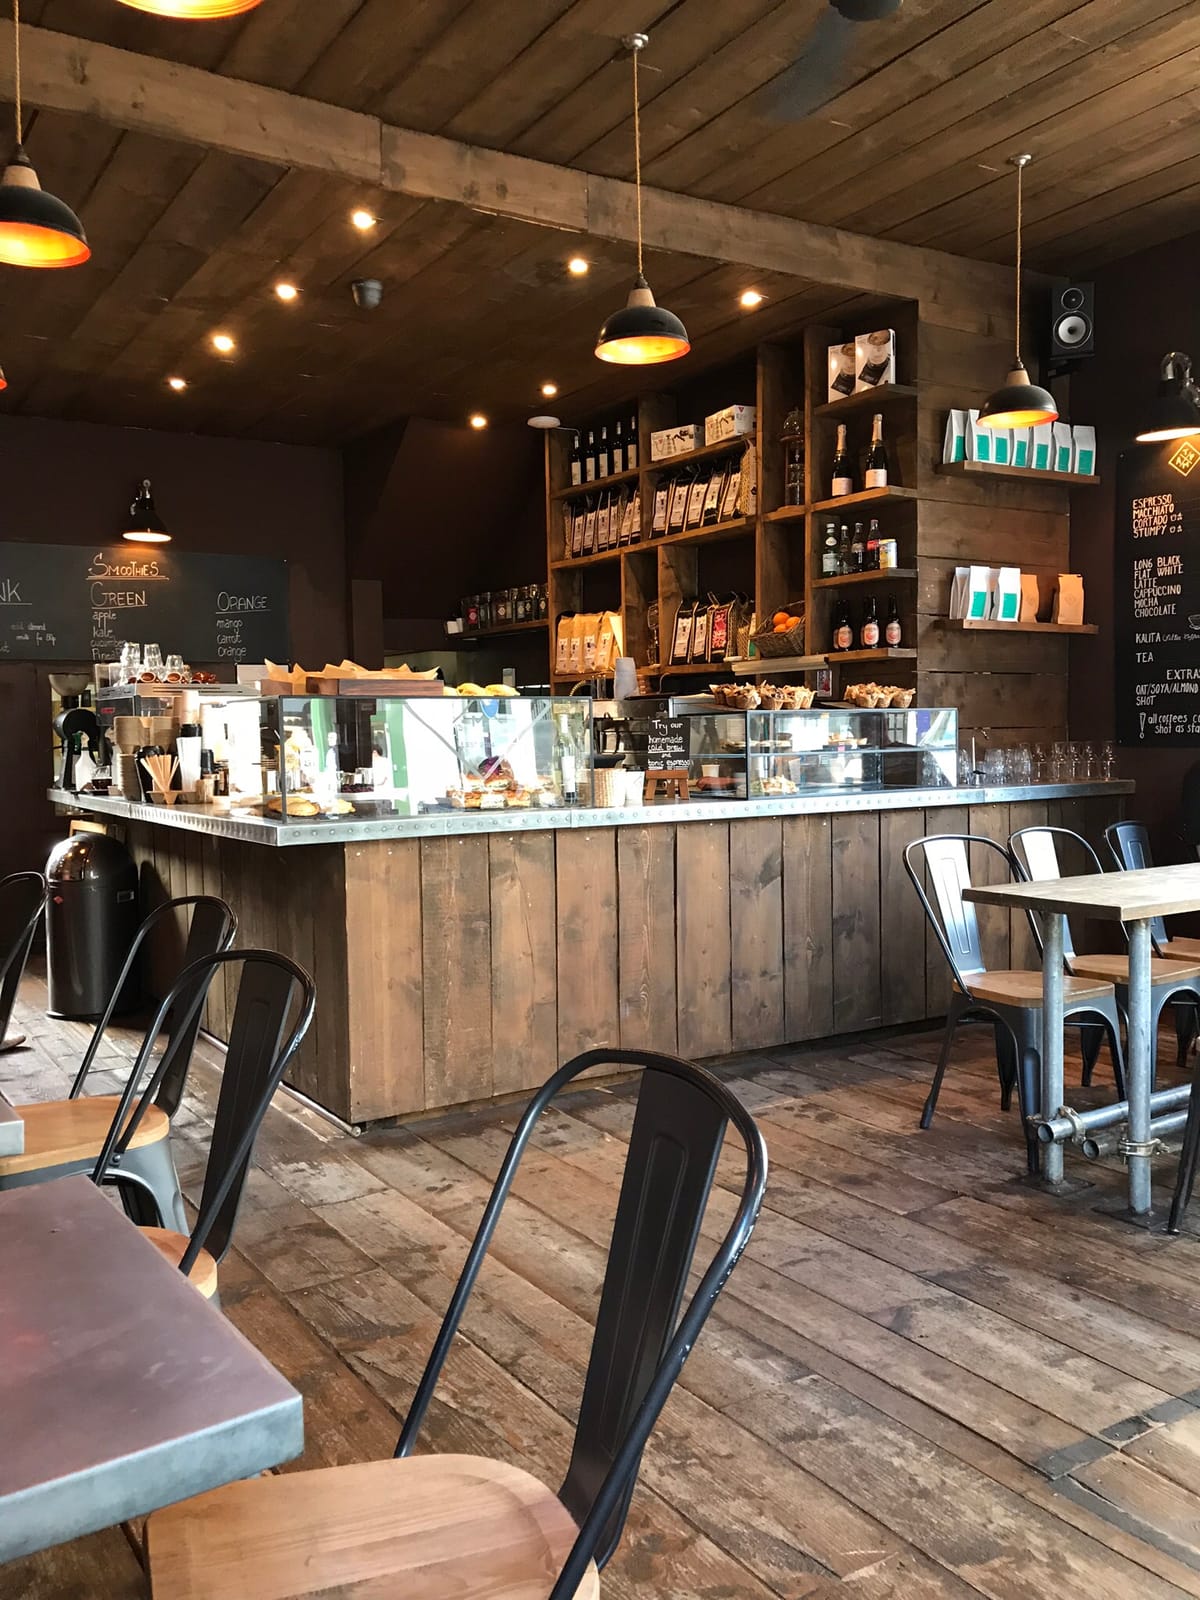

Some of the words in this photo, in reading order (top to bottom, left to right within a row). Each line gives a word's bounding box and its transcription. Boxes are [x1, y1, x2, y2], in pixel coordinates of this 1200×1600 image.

[1132, 494, 1172, 510] ESPRESSO
[1132, 503, 1175, 520] MACCHIATO
[1133, 514, 1168, 530] CORTADO
[1133, 524, 1167, 539] STUMPY
[1134, 558, 1153, 571] LONG
[1157, 555, 1181, 567] BLACK
[1134, 568, 1151, 580] FLAT
[1157, 563, 1184, 577] WHITE
[1134, 577, 1157, 590] LATTE
[90, 581, 146, 607] GREEN
[1134, 584, 1181, 600] CAPPUCCINO
[217, 591, 268, 611] ORANGE
[1134, 597, 1158, 609] MOCHA
[1135, 603, 1177, 618] CHOCOLATE
[92, 609, 117, 628] apple
[93, 626, 113, 638] kale
[216, 619, 243, 633] mango
[1135, 632, 1160, 643] KALITA
[1135, 652, 1154, 663] TEA
[1135, 682, 1199, 696] OAT/SOYA/ALMOND
[1136, 695, 1156, 706] SHOT
[1147, 713, 1158, 724] all
[1158, 714, 1188, 725] coffees
[651, 719, 668, 736] Try
[1154, 723, 1172, 734] shot
[1175, 725, 1185, 733] as
[648, 733, 684, 744] homemade
[647, 743, 664, 751] cold
[666, 743, 684, 751] brew
